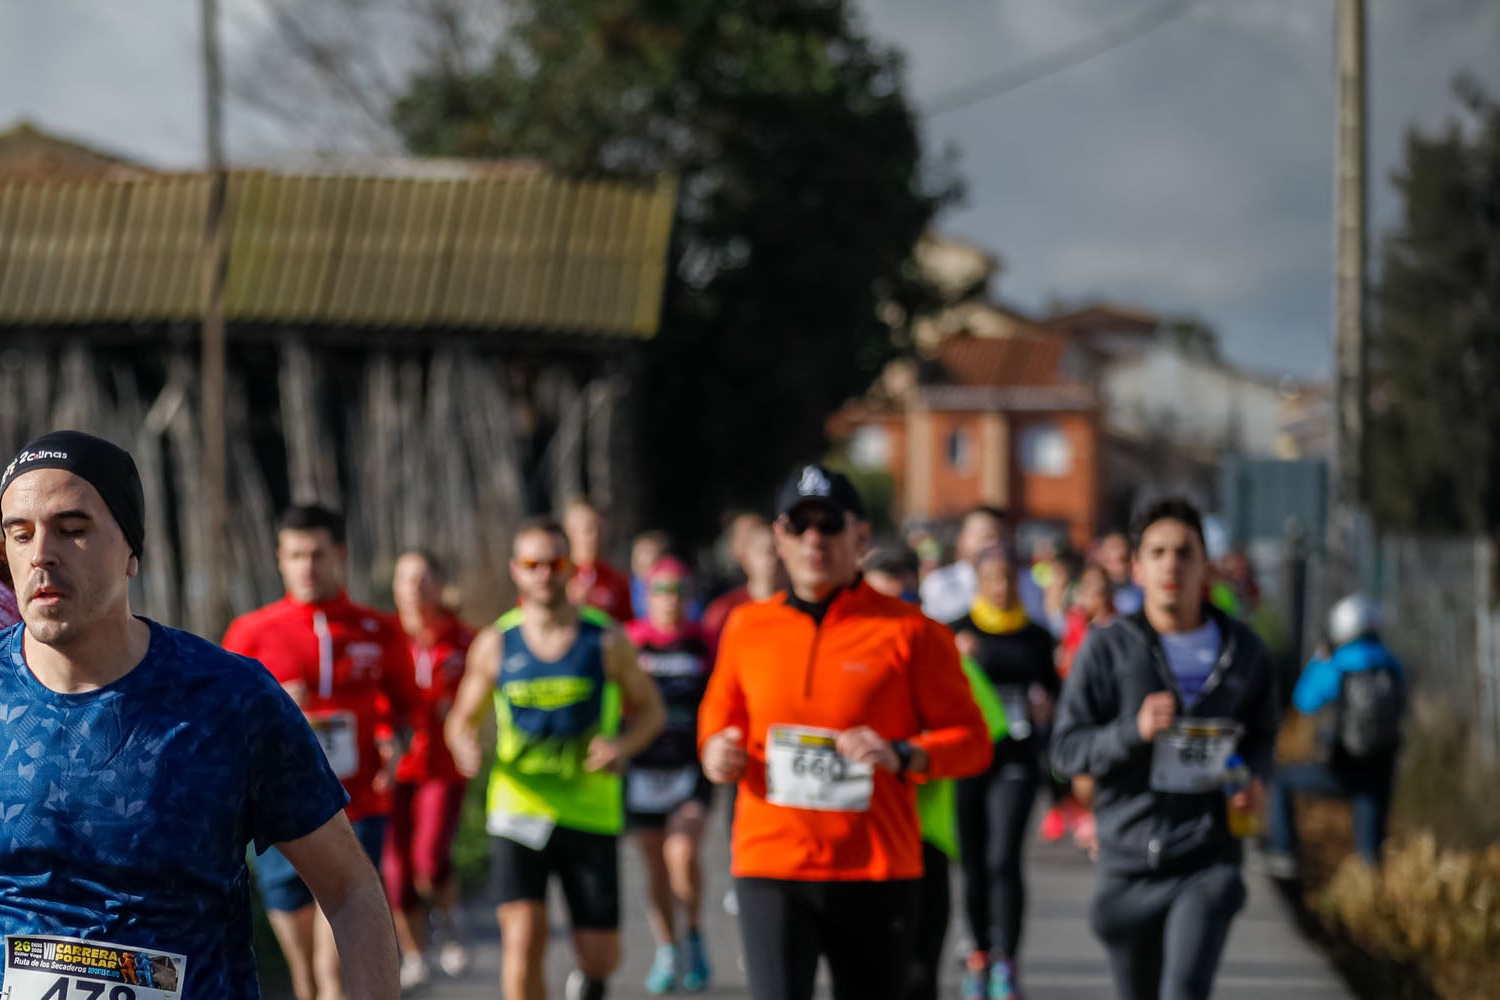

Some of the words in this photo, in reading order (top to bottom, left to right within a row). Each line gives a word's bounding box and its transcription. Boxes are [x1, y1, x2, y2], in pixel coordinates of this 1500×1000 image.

[14, 941, 31, 952] 26
[56, 943, 118, 962] CARRERA
[14, 957, 29, 966] Ruta
[31, 959, 40, 967] de
[40, 961, 50, 969] los
[51, 962, 87, 974] Secaderos
[55, 953, 117, 969] POPULAR
